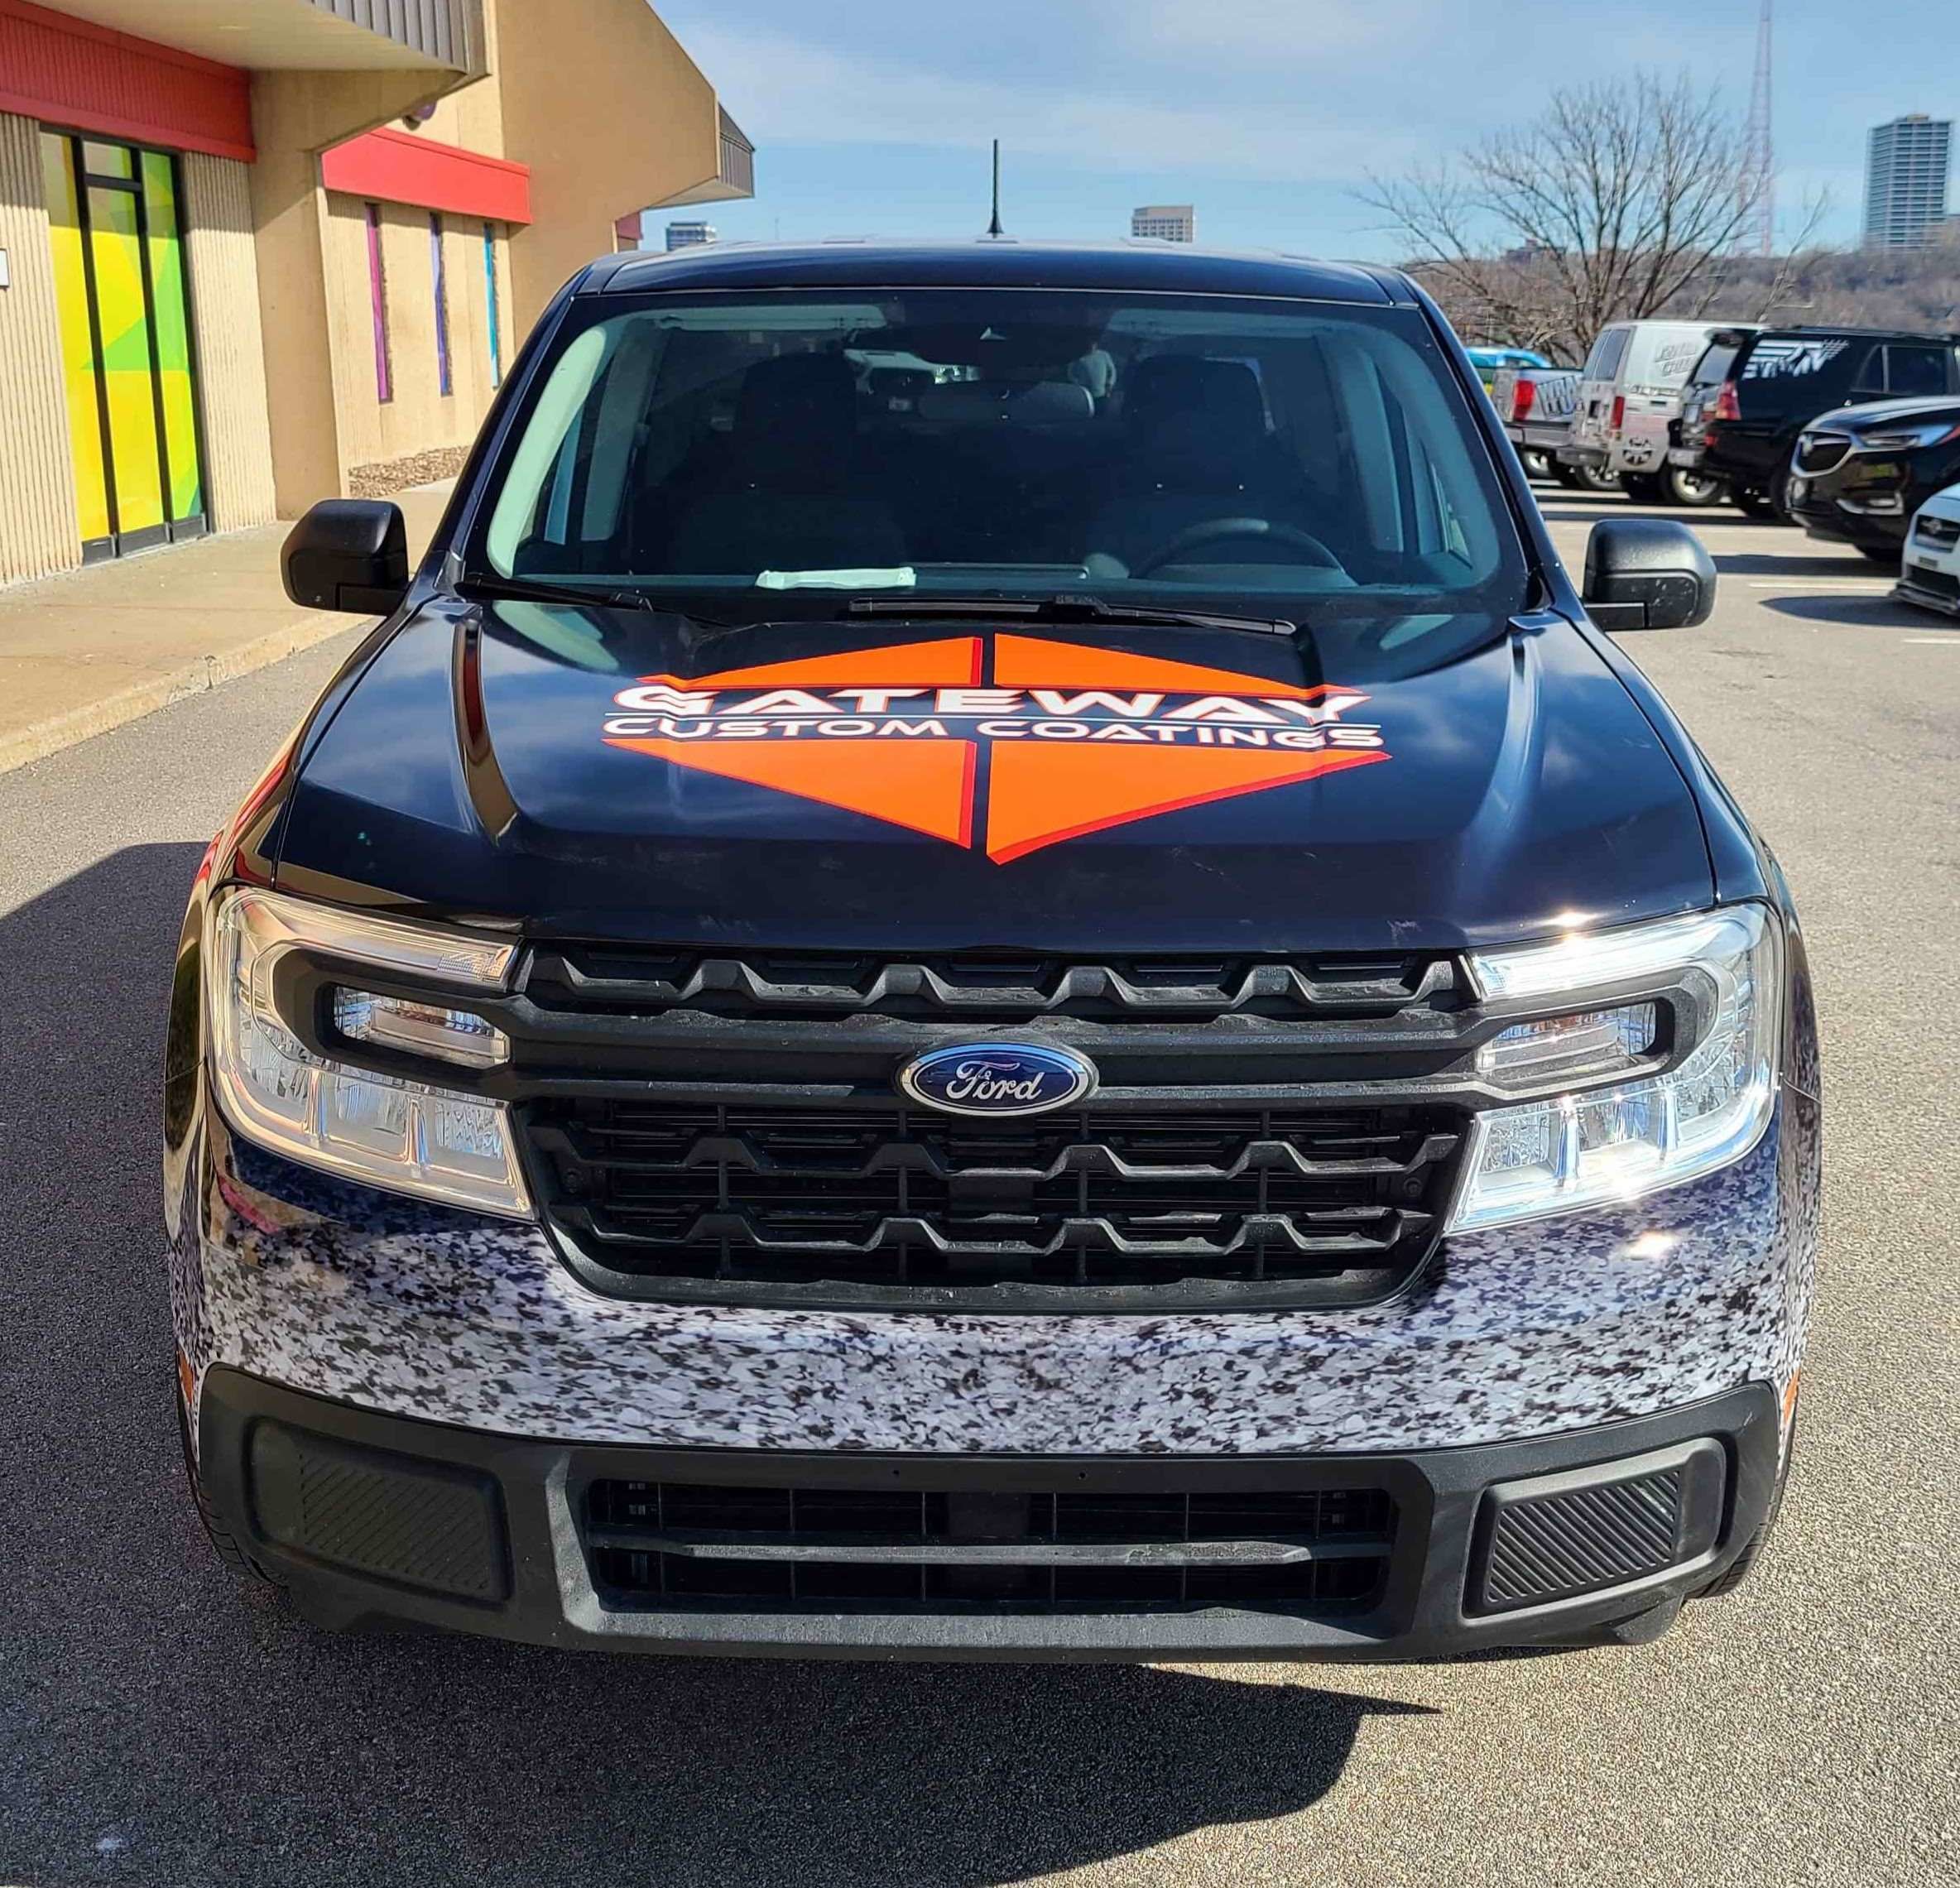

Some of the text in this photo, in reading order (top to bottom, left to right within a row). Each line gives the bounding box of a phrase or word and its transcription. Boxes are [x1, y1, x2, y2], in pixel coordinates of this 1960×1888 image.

[613, 685, 1372, 723] GATEWAY
[603, 718, 1385, 749] CUSTOM COATINGS
[945, 1060, 1045, 1100] Ford
